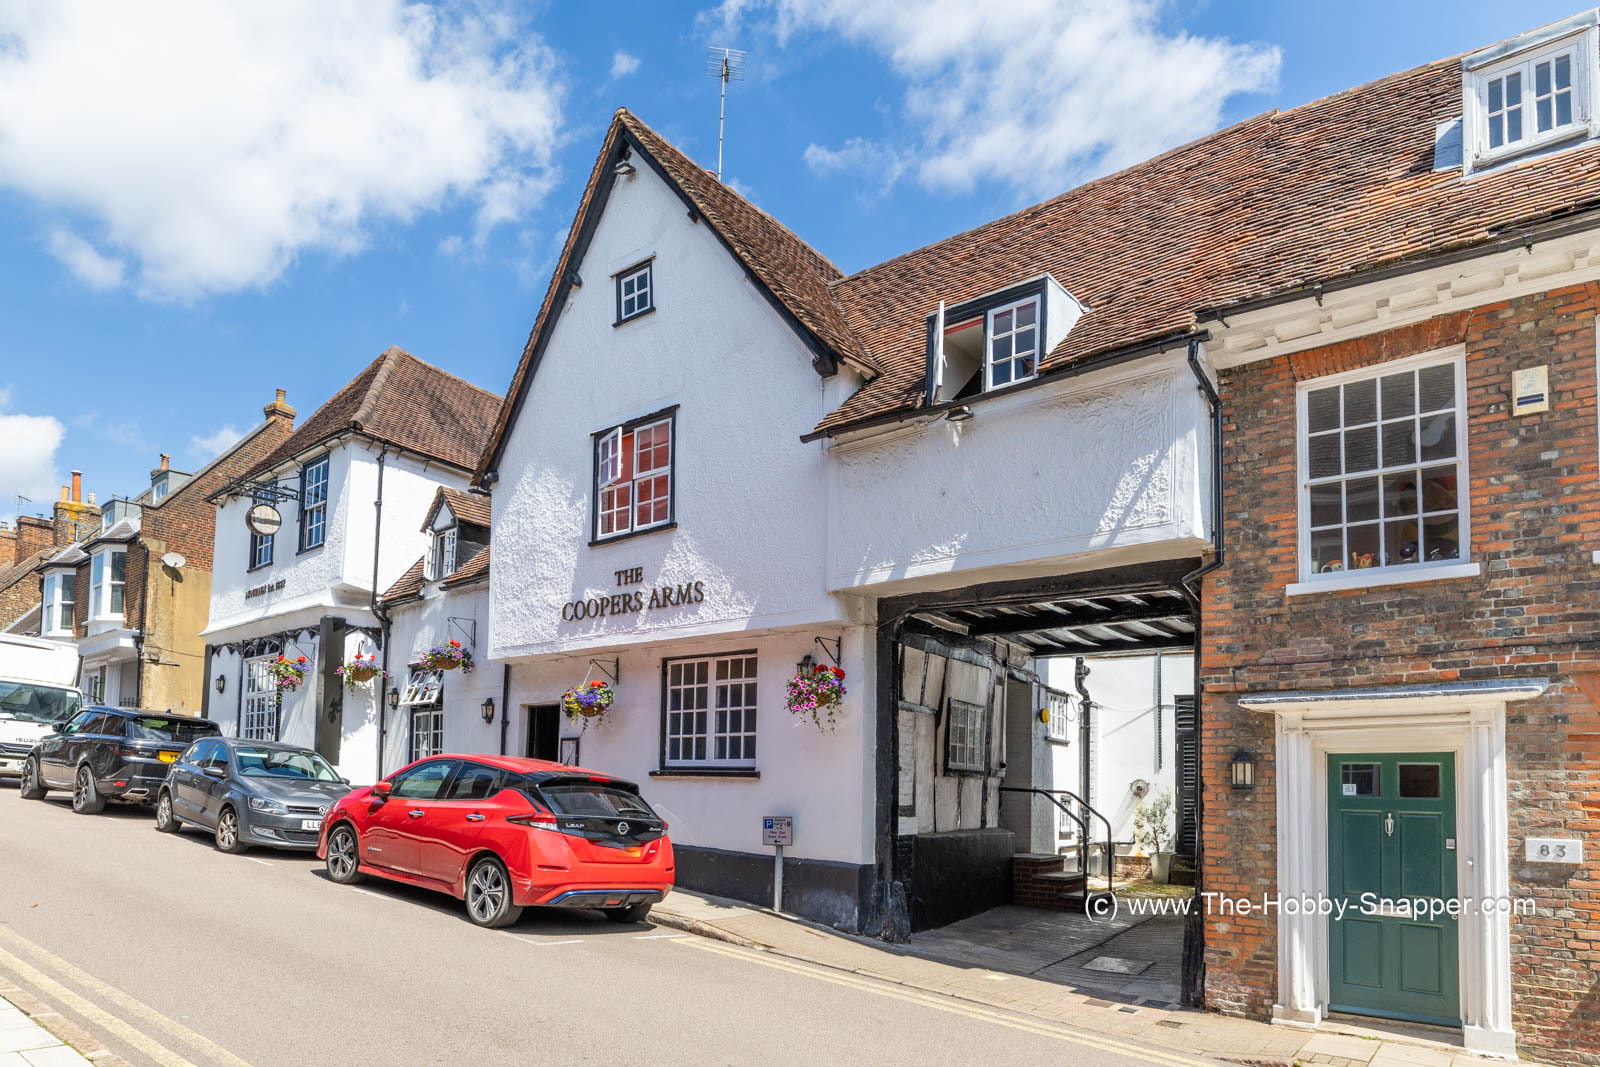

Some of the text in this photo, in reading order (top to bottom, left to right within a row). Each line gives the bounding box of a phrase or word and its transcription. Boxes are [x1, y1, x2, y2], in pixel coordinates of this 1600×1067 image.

[614, 567, 643, 586] THE
[562, 580, 704, 622] COOPERS ARMS
[1540, 844, 1566, 858] 83
